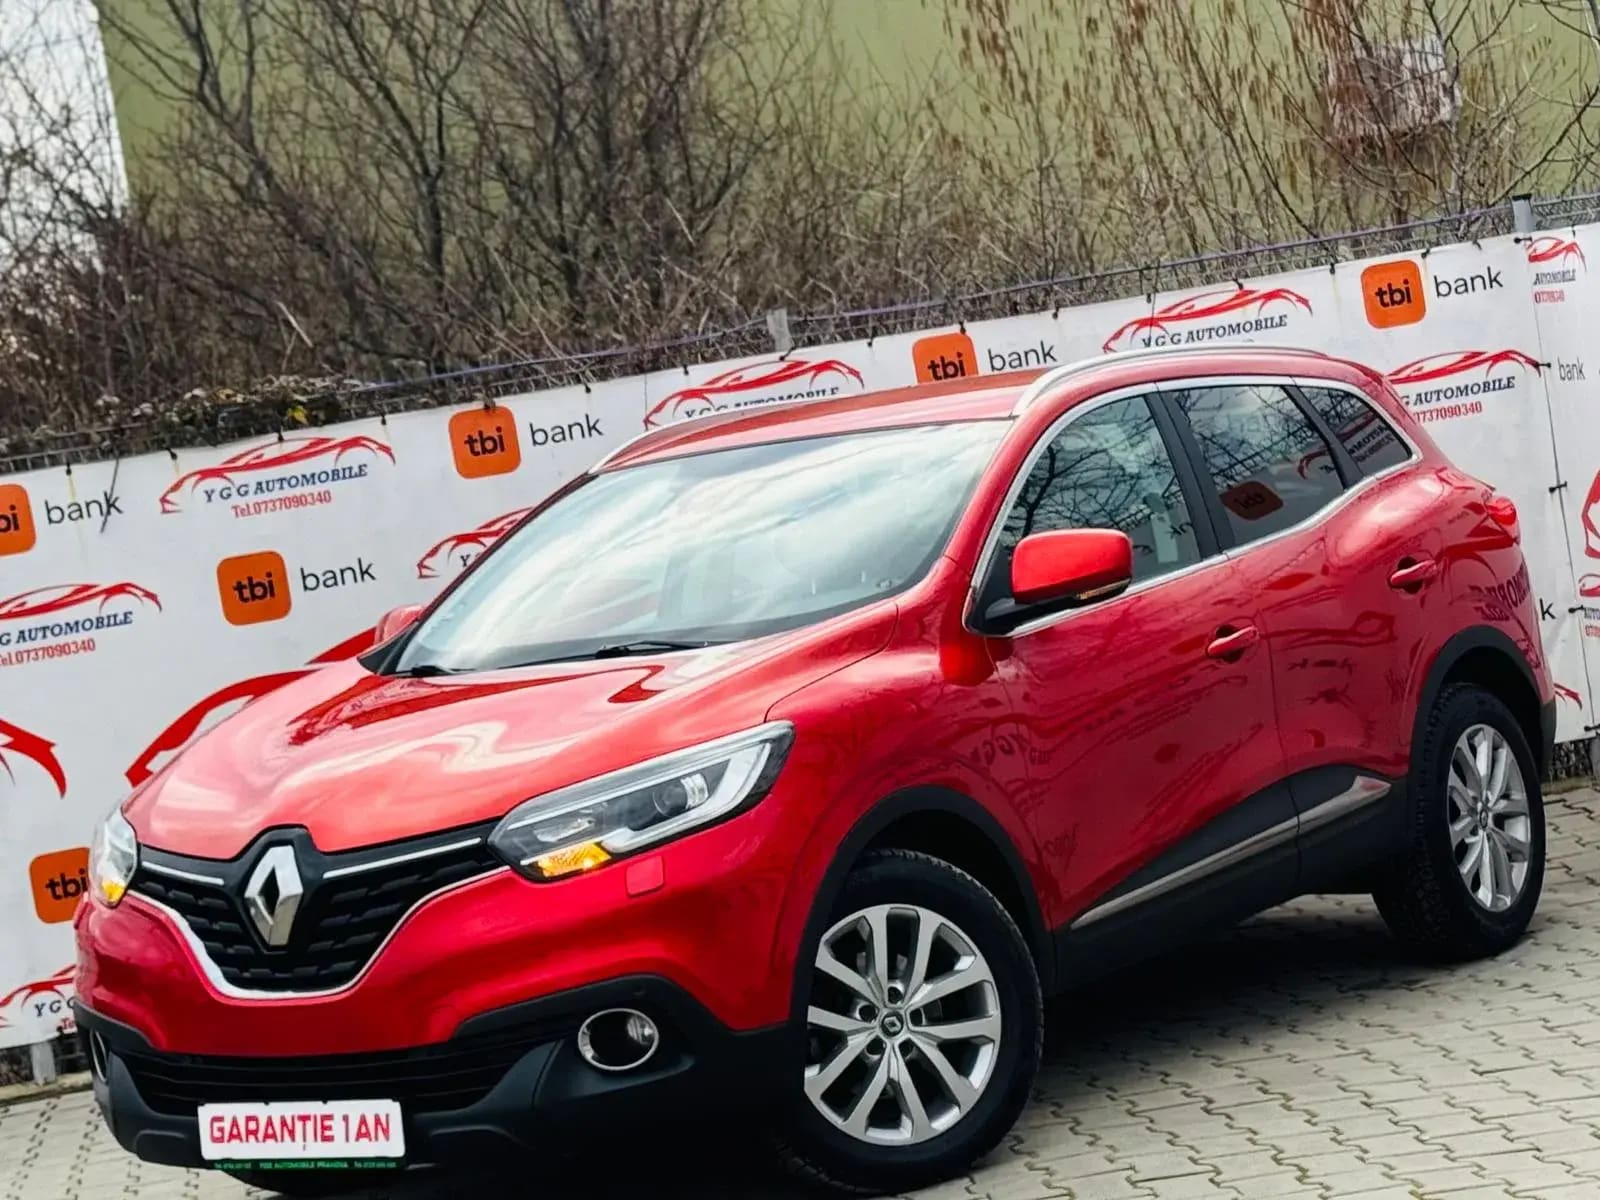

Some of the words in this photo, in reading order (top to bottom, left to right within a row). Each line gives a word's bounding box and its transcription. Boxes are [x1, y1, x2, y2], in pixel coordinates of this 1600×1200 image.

[1375, 278, 1412, 308] tbi
[1433, 266, 1503, 298] bank
[1185, 314, 1288, 344] AUTOMOBILE
[928, 352, 966, 381] tbi
[987, 340, 1058, 372] bank
[1557, 355, 1586, 381] bank
[1413, 376, 1516, 406] AUTOMOBILE
[464, 426, 507, 457] tbi
[529, 413, 604, 447] bank
[254, 464, 368, 495] AUTOMOBILE
[45, 491, 124, 525] bank
[233, 571, 276, 603] tbi
[300, 557, 376, 592] bank
[16, 611, 133, 644] AUTOMOBILE
[45, 868, 88, 901] tbi
